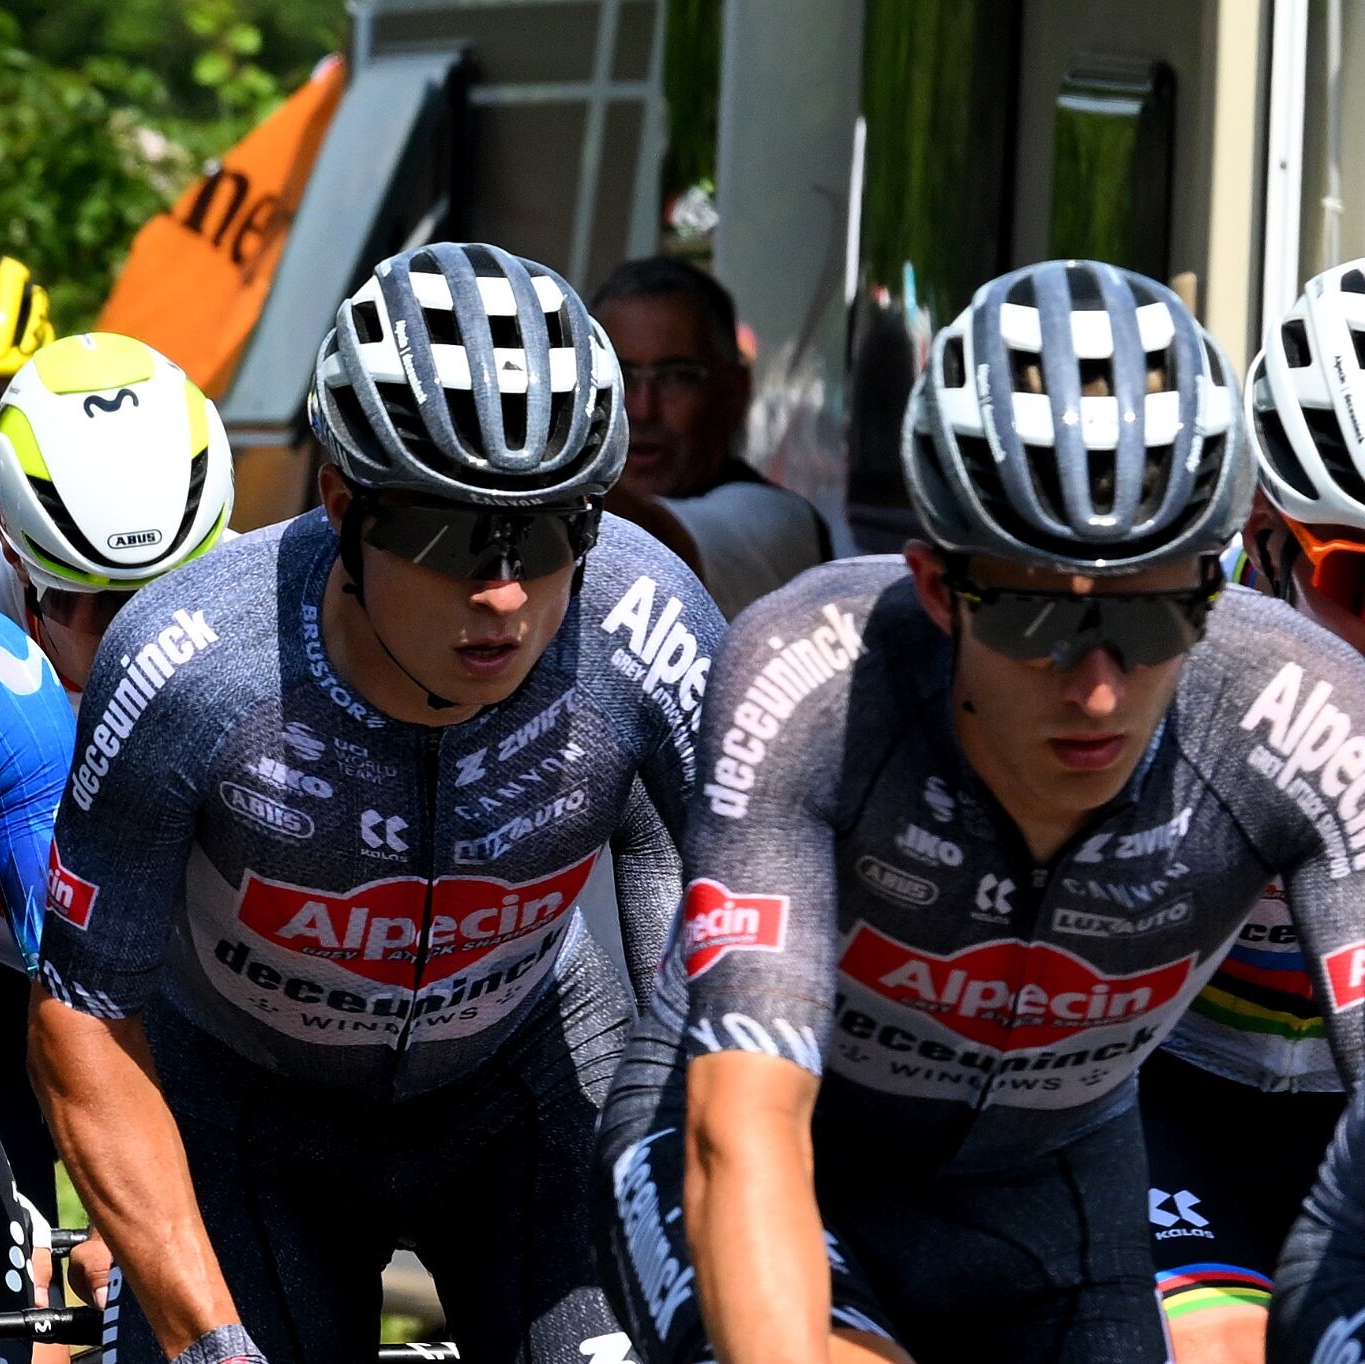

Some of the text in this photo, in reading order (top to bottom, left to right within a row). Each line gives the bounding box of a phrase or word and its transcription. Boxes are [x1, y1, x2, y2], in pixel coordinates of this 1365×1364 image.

[471, 493, 544, 507] CANYON
[115, 533, 156, 546] ABUS
[299, 604, 371, 724] BRUSTOR
[72, 604, 220, 812] deceuninck
[500, 687, 578, 763] ZWIFT
[709, 604, 867, 820] deceuninck
[334, 738, 369, 758] UCI
[455, 744, 585, 819] CANYON
[232, 787, 303, 833] ABUS
[869, 863, 931, 900] ABUS
[289, 888, 562, 959] Alpecin
[215, 926, 562, 1020] deceuninck
[879, 957, 1153, 1021] Alpecin
